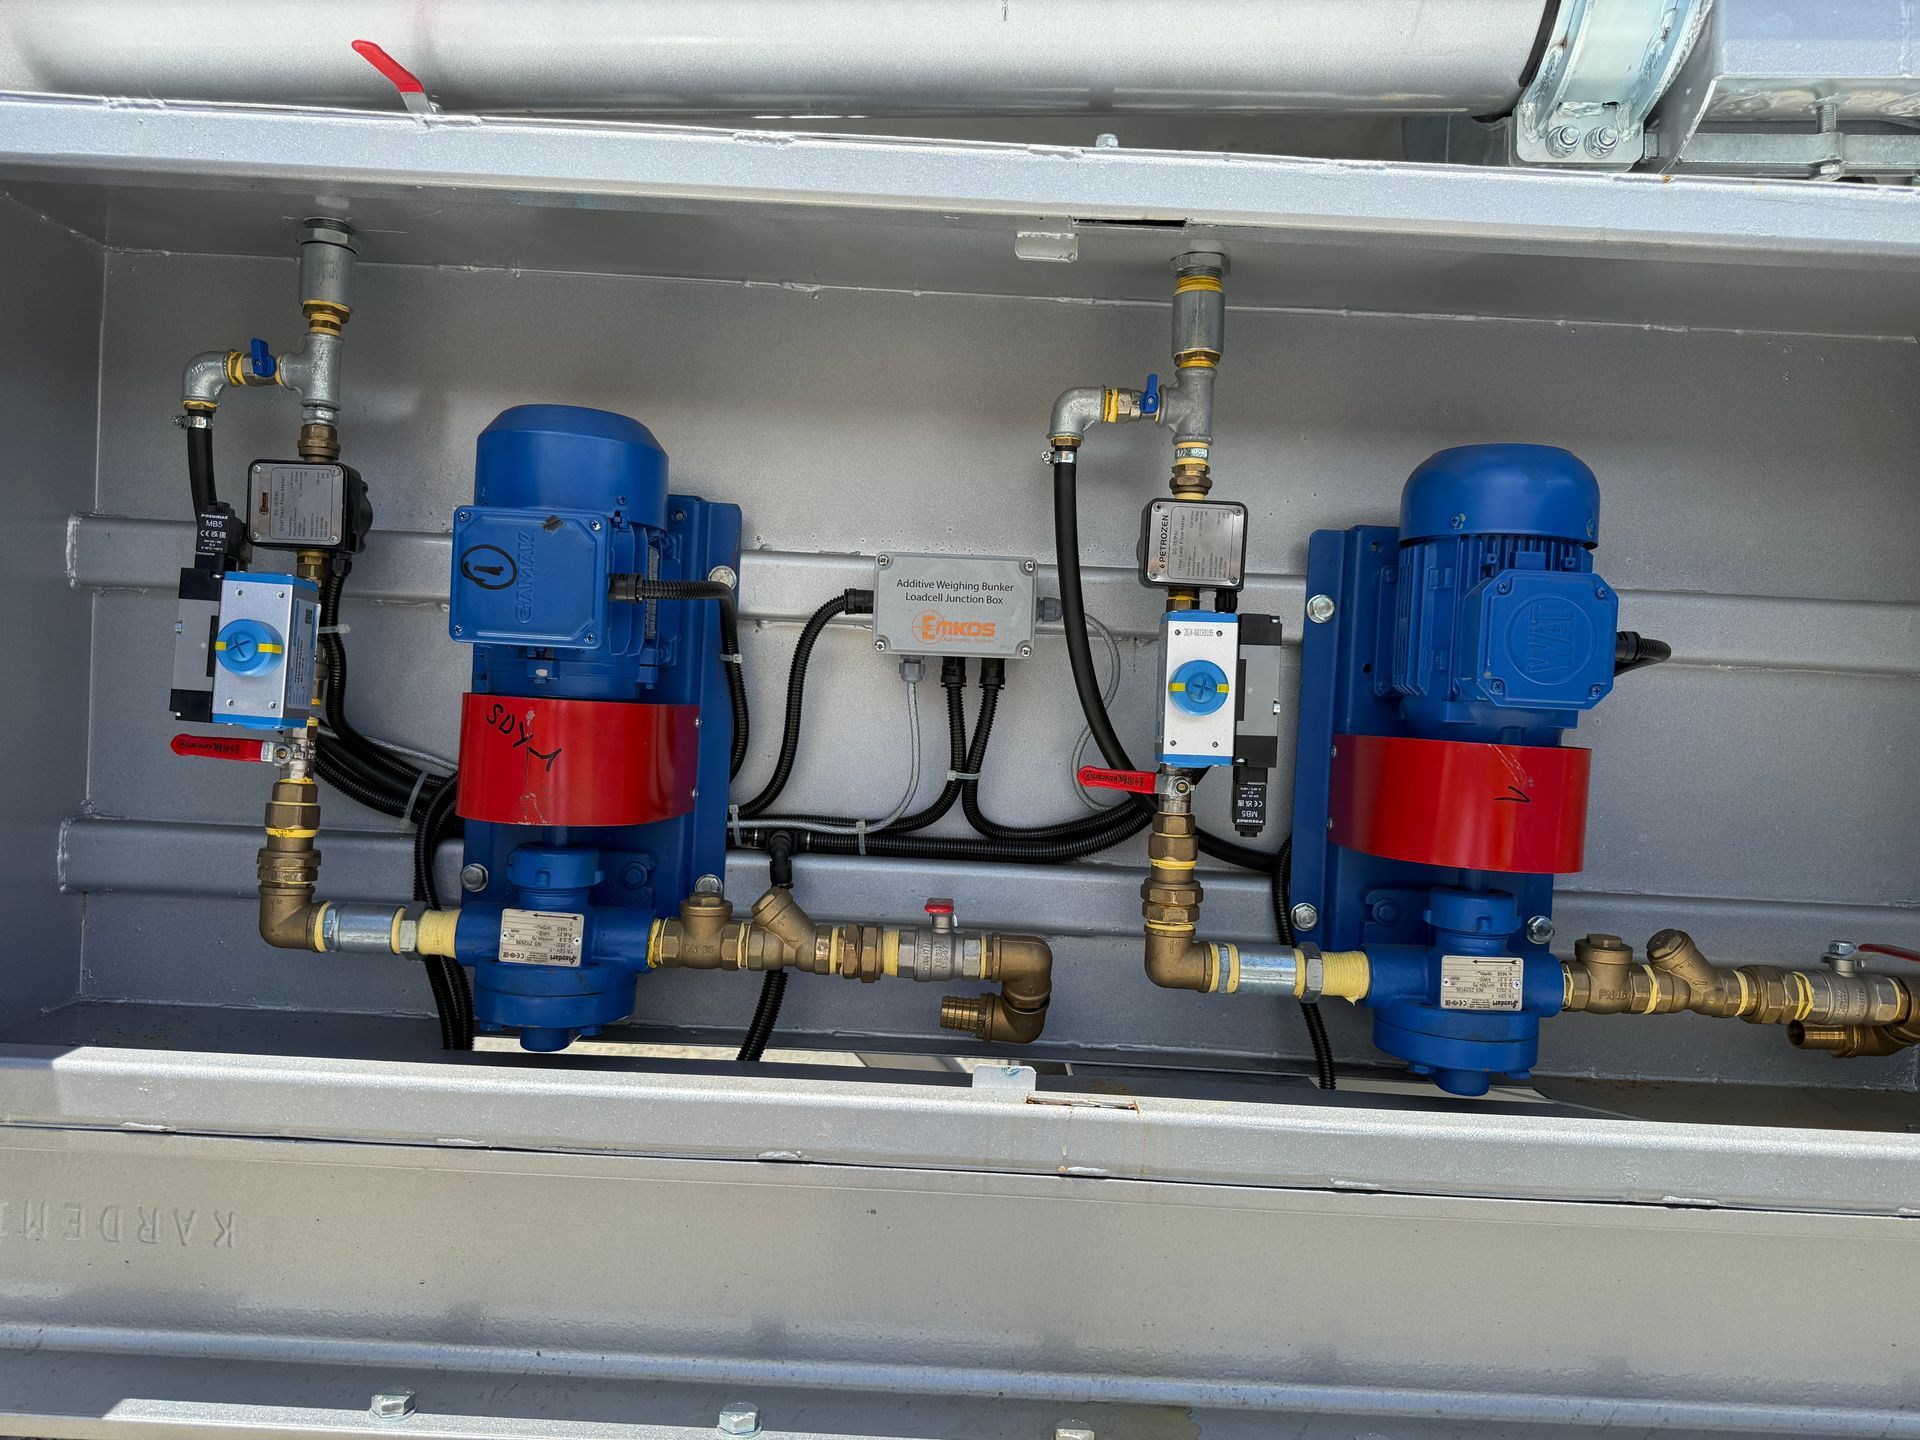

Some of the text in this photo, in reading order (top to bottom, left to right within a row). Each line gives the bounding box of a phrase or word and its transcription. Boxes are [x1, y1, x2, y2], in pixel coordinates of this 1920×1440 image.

[1159, 514, 1169, 562] PETROZEN
[896, 578, 1014, 592] Additive Weighing Bunker
[906, 592, 1004, 604] Loadcell Junction Box
[550, 954, 577, 964] Standart
[1492, 1000, 1518, 1008] Standart
